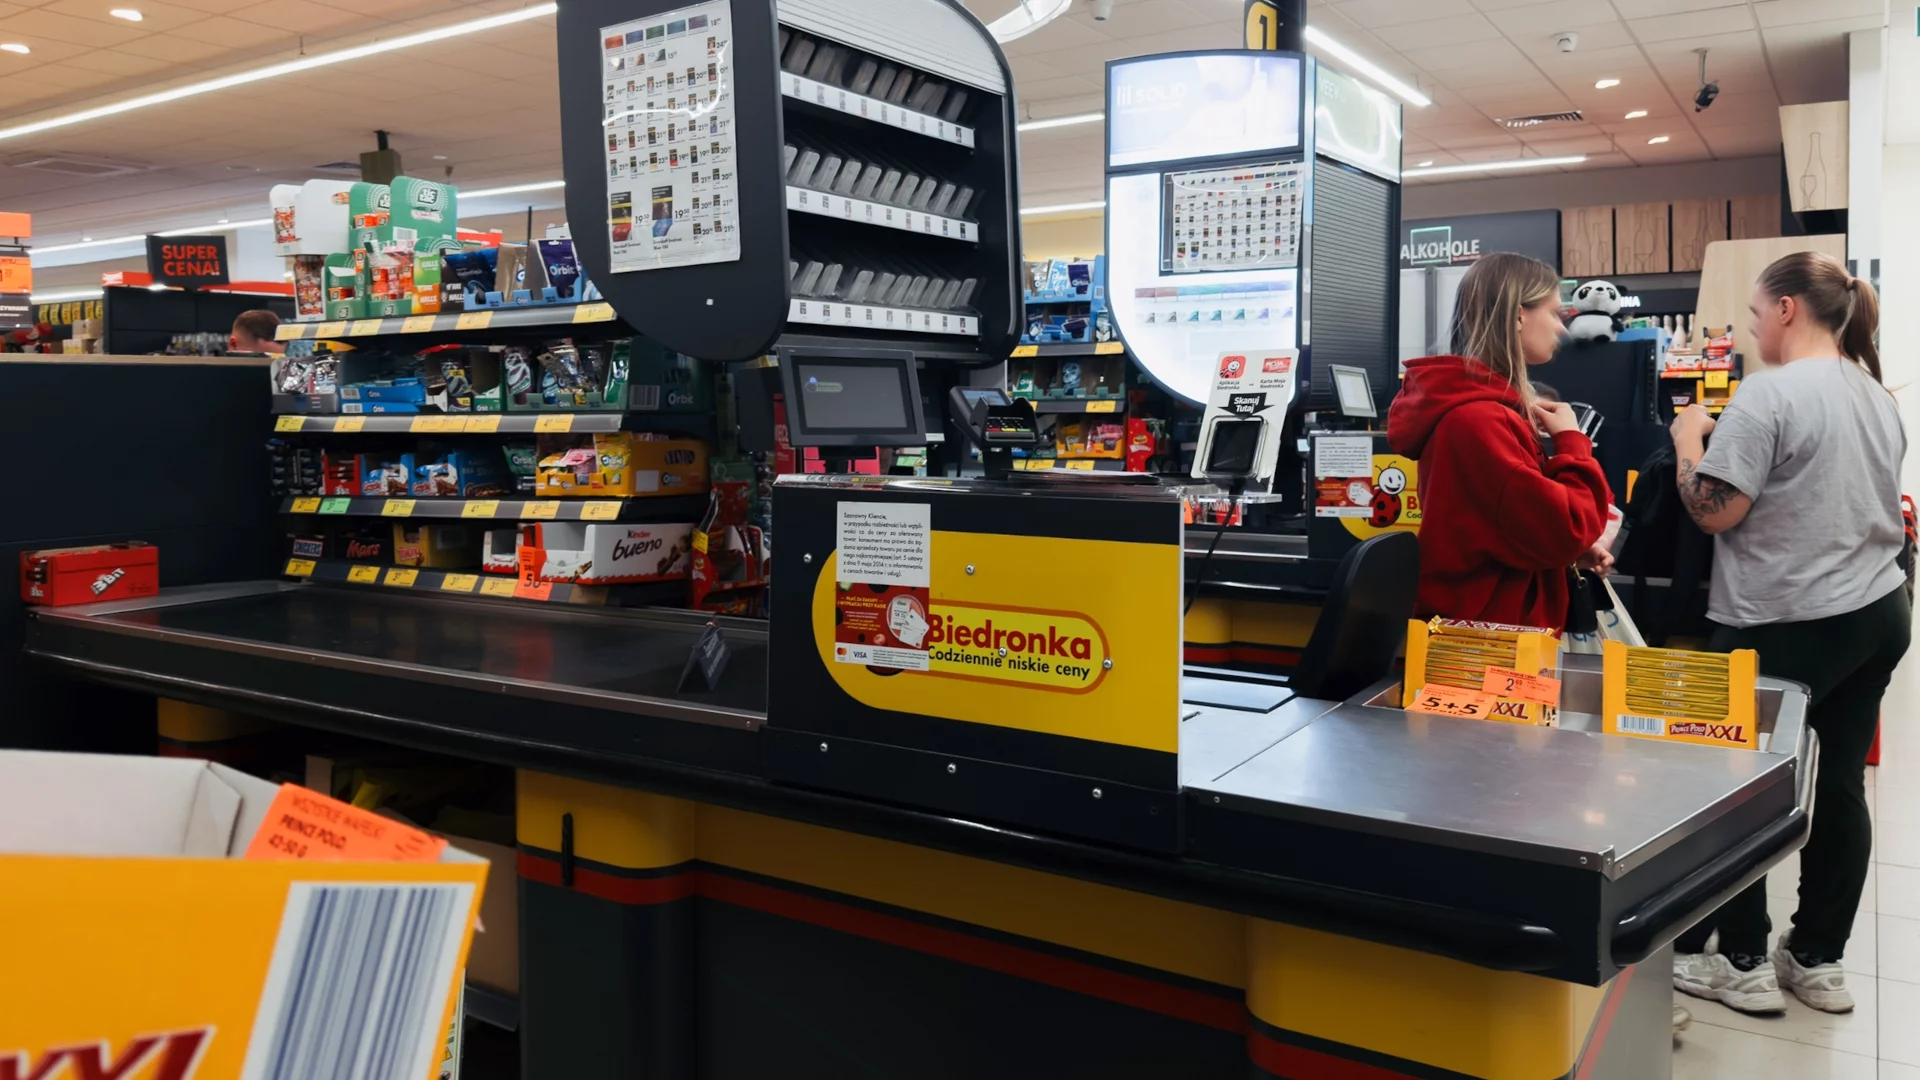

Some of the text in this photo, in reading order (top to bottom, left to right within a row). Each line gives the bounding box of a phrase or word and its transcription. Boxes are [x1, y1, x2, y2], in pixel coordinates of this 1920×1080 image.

[1258, 14, 1268, 50] 1
[162, 245, 218, 260] SUPER
[1400, 239, 1480, 260] ALKOHOLE
[163, 260, 220, 276] CENA!
[549, 263, 576, 276] Orbit
[1620, 295, 1641, 308] INA
[1234, 396, 1260, 405] Skanuj
[1236, 404, 1254, 413] Tutaj
[347, 540, 380, 559] Mars
[611, 537, 663, 562] bueno
[929, 614, 1091, 660] Biedronka
[853, 651, 867, 659] VISA
[929, 645, 1003, 668] Codziennie
[1008, 655, 1050, 673] niskie
[1055, 664, 1090, 681] ceny
[1421, 697, 1479, 714] 5+5
[1493, 701, 1529, 719] XXL
[1671, 724, 1748, 743] PRINCE POLO XXL
[280, 813, 347, 850] PRINCE POLO
